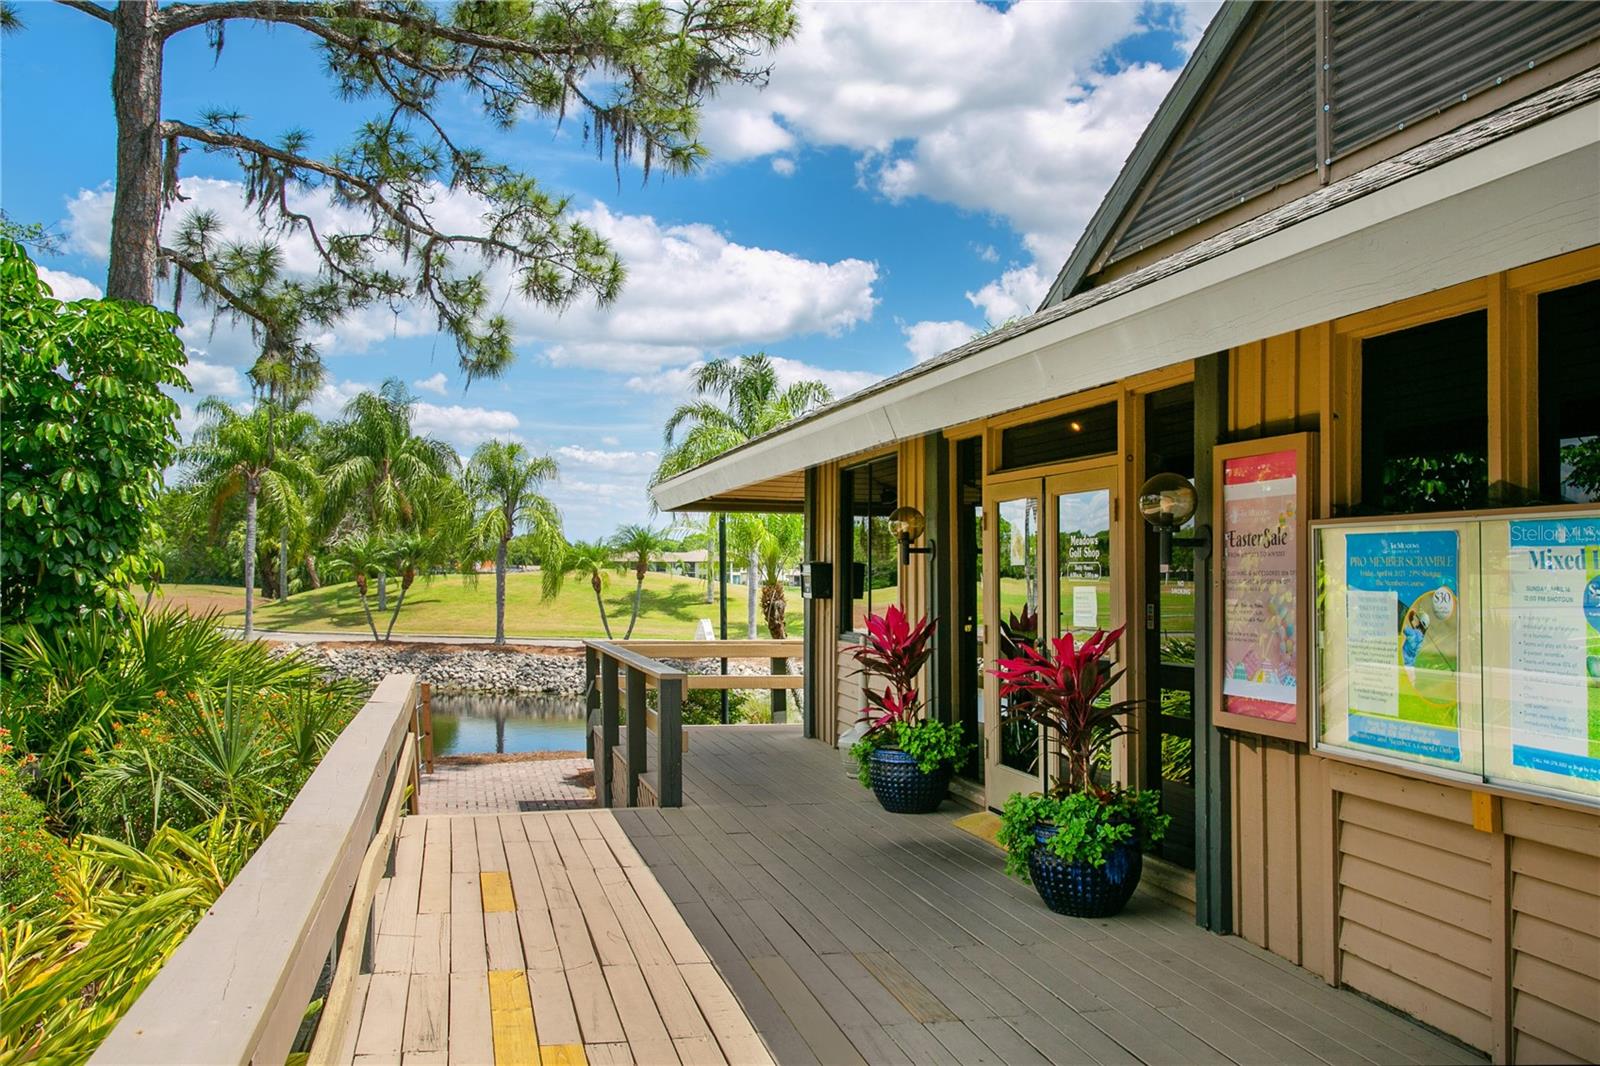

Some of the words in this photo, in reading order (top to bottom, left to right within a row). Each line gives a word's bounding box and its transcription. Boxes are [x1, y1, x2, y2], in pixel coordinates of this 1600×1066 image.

[1070, 535, 1099, 546] Meadows
[1226, 529, 1263, 548] Easter
[1263, 526, 1288, 549] Sale
[1069, 547, 1082, 558] Golf
[1083, 547, 1100, 560] Shop
[1528, 548, 1586, 571] Mixed
[1405, 554, 1454, 567] SCRAMBLE
